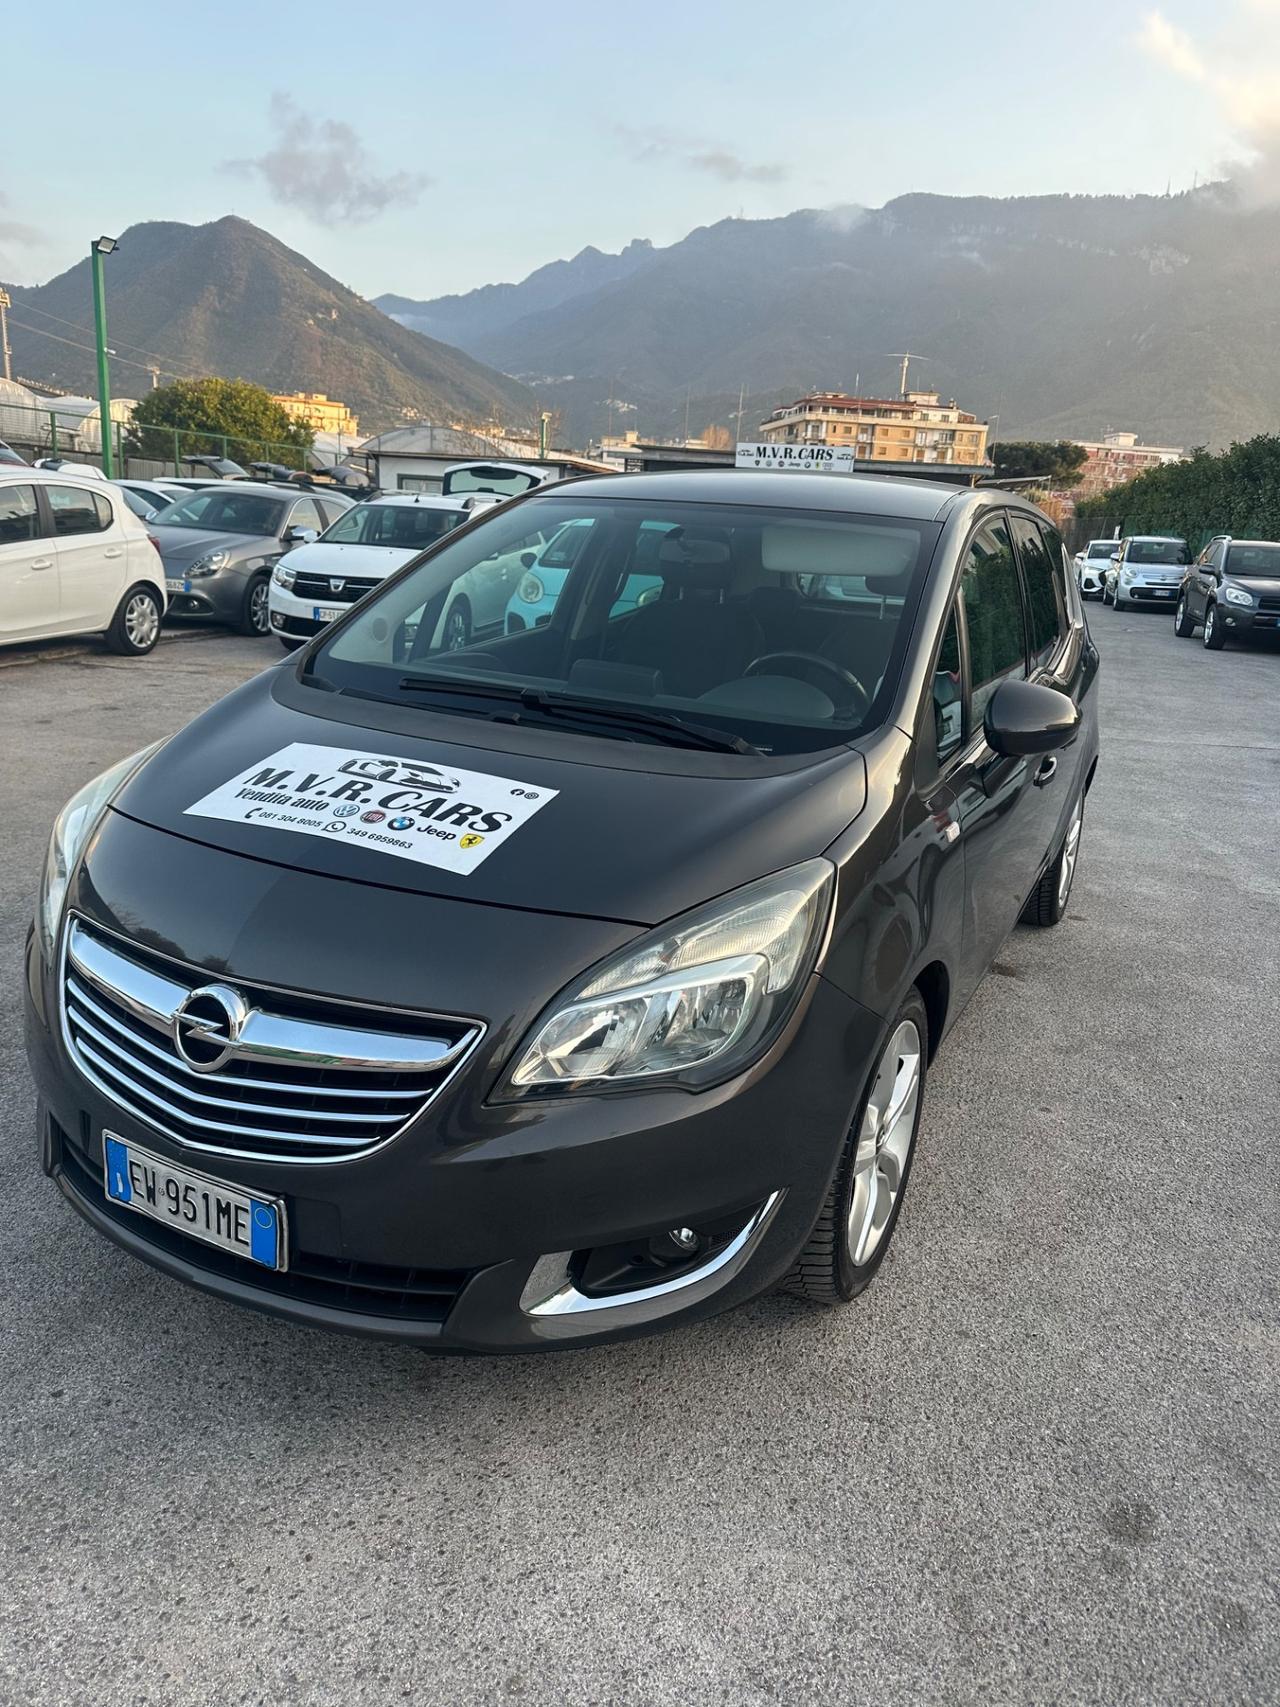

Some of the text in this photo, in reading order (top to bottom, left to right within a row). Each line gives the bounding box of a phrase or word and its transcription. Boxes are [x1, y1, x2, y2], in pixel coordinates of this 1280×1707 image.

[234, 788, 330, 811] Vendita auto
[258, 811, 323, 828] 081 304 8005
[346, 827, 413, 849] 349 6959863
[416, 825, 457, 841] Jeep
